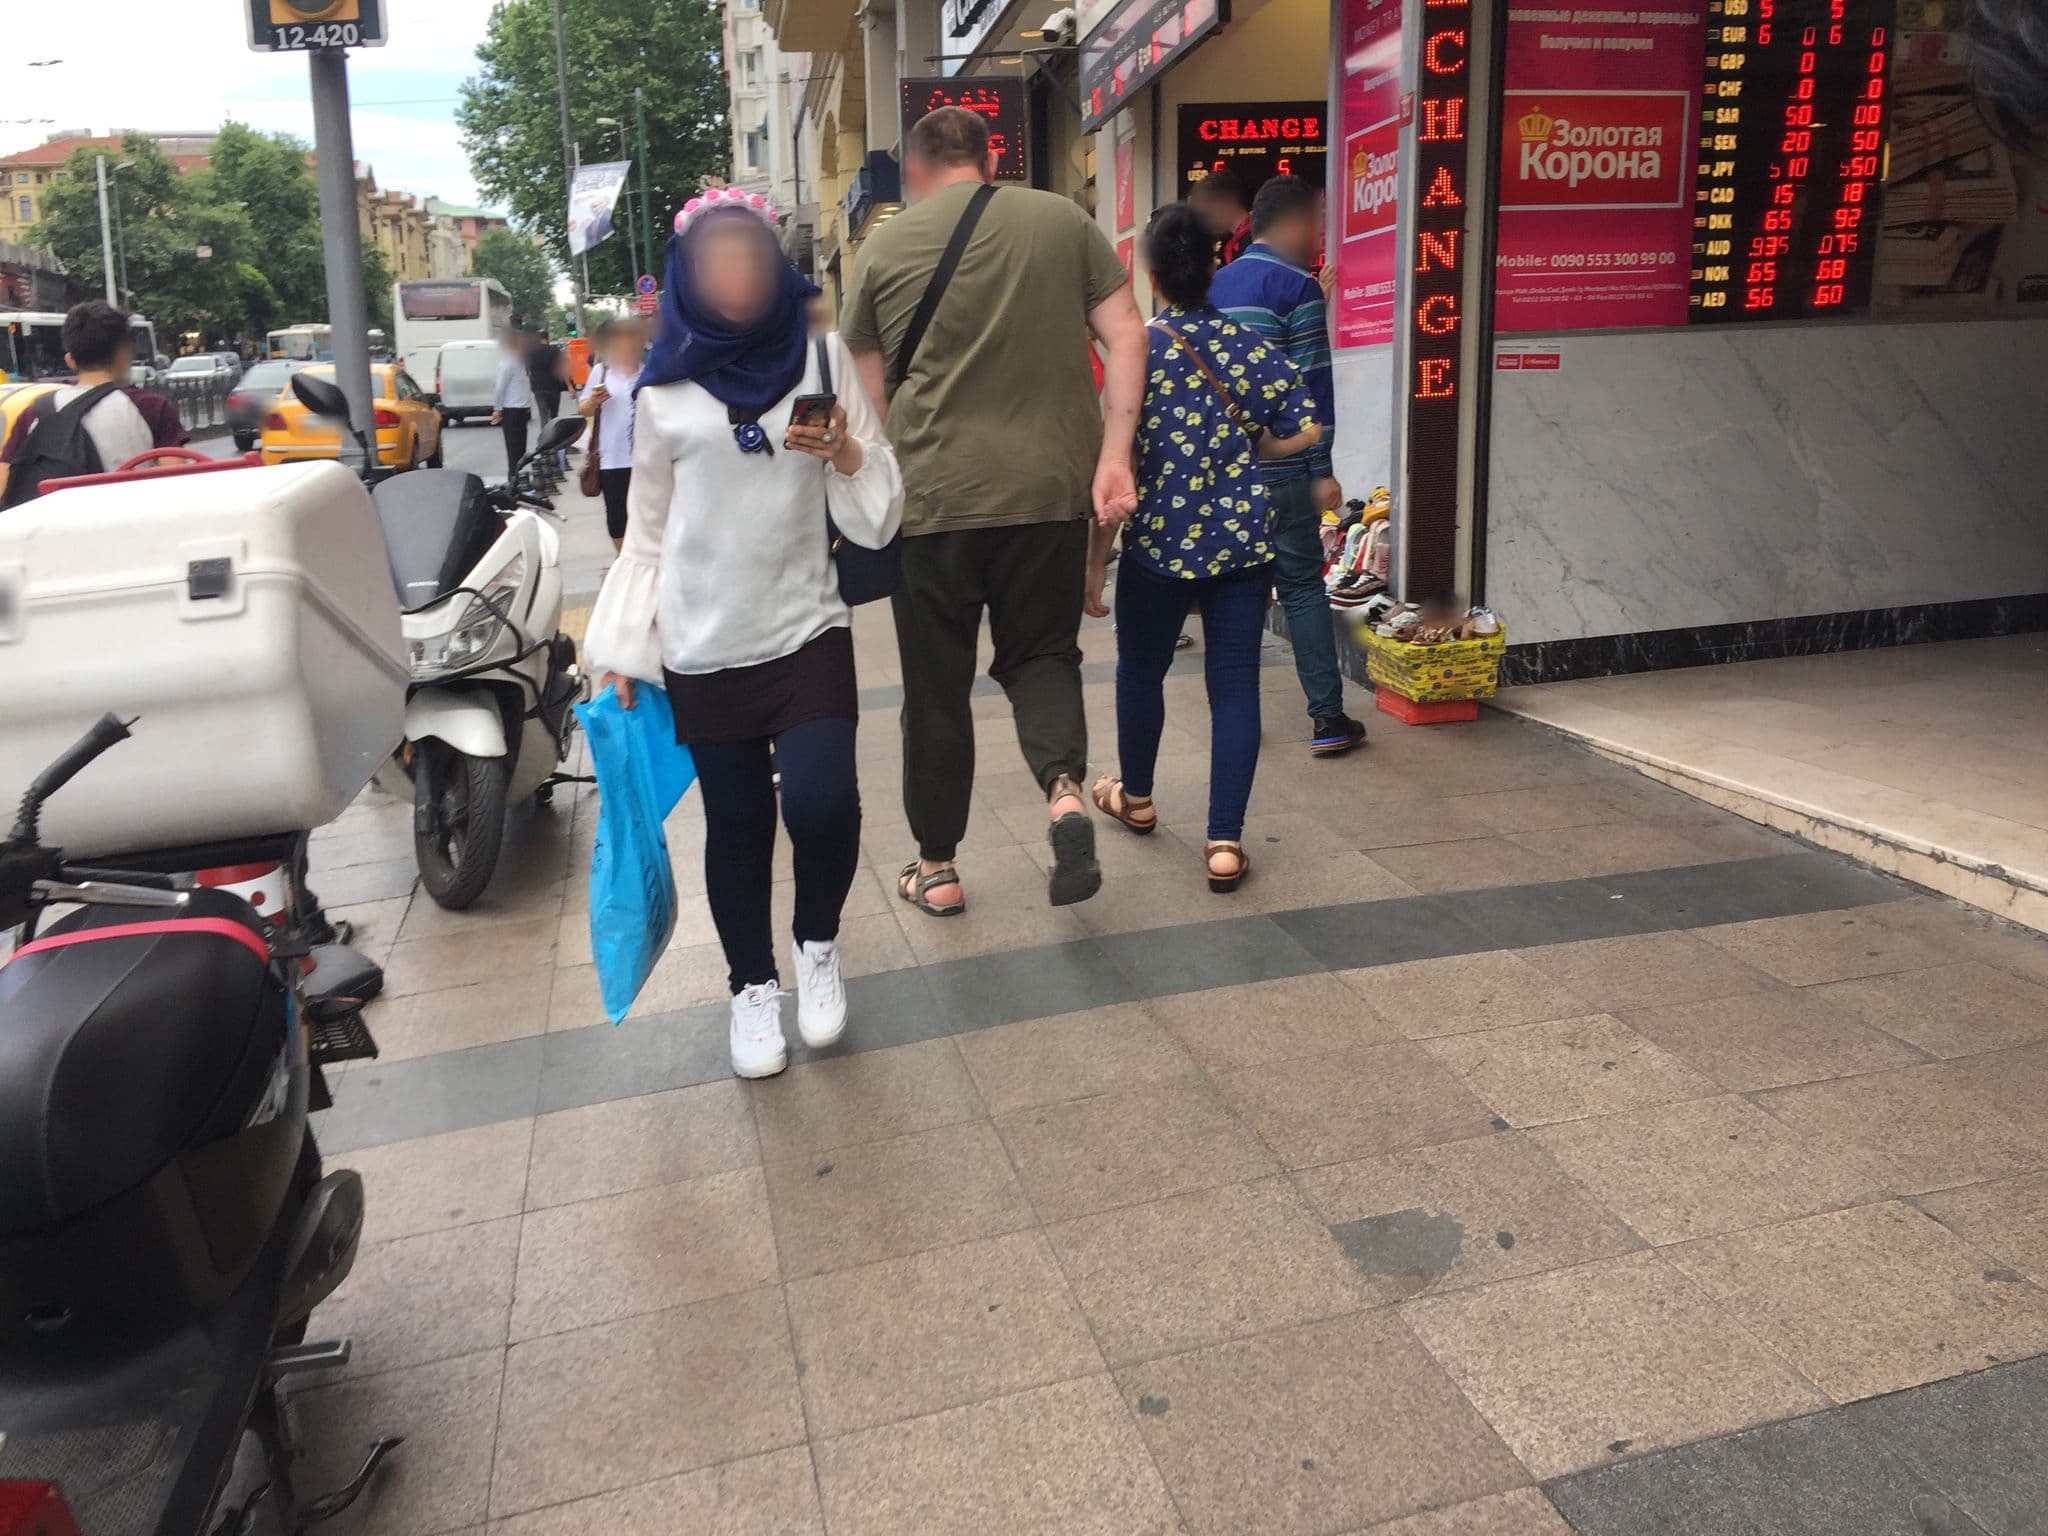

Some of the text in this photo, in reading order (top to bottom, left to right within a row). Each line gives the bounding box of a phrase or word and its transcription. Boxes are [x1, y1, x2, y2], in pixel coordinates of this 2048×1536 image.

[276, 24, 358, 49] 12-420
[1722, 26, 1747, 42] EUR
[1720, 54, 1745, 70] GBP
[1718, 80, 1743, 97] CHF
[1715, 108, 1740, 124] SAR
[1199, 118, 1320, 140] CHANGE
[1552, 118, 1664, 148] Золотая
[1714, 135, 1738, 150] SEK
[1519, 142, 1662, 188] Корона
[1712, 161, 1735, 177] JPY
[1418, 0, 1469, 399] CHANGE
[1711, 187, 1735, 203] CAD
[1708, 214, 1733, 229] DKK
[1764, 210, 1792, 231] 65
[1706, 240, 1731, 255] AUD
[1496, 255, 1547, 267] Mobile:
[1551, 254, 1584, 267] 0090
[1586, 254, 1612, 266] 553
[1614, 252, 1639, 265] 300
[1658, 251, 1676, 264] 00
[1704, 266, 1730, 282] NOK
[1702, 292, 1727, 307] AED
